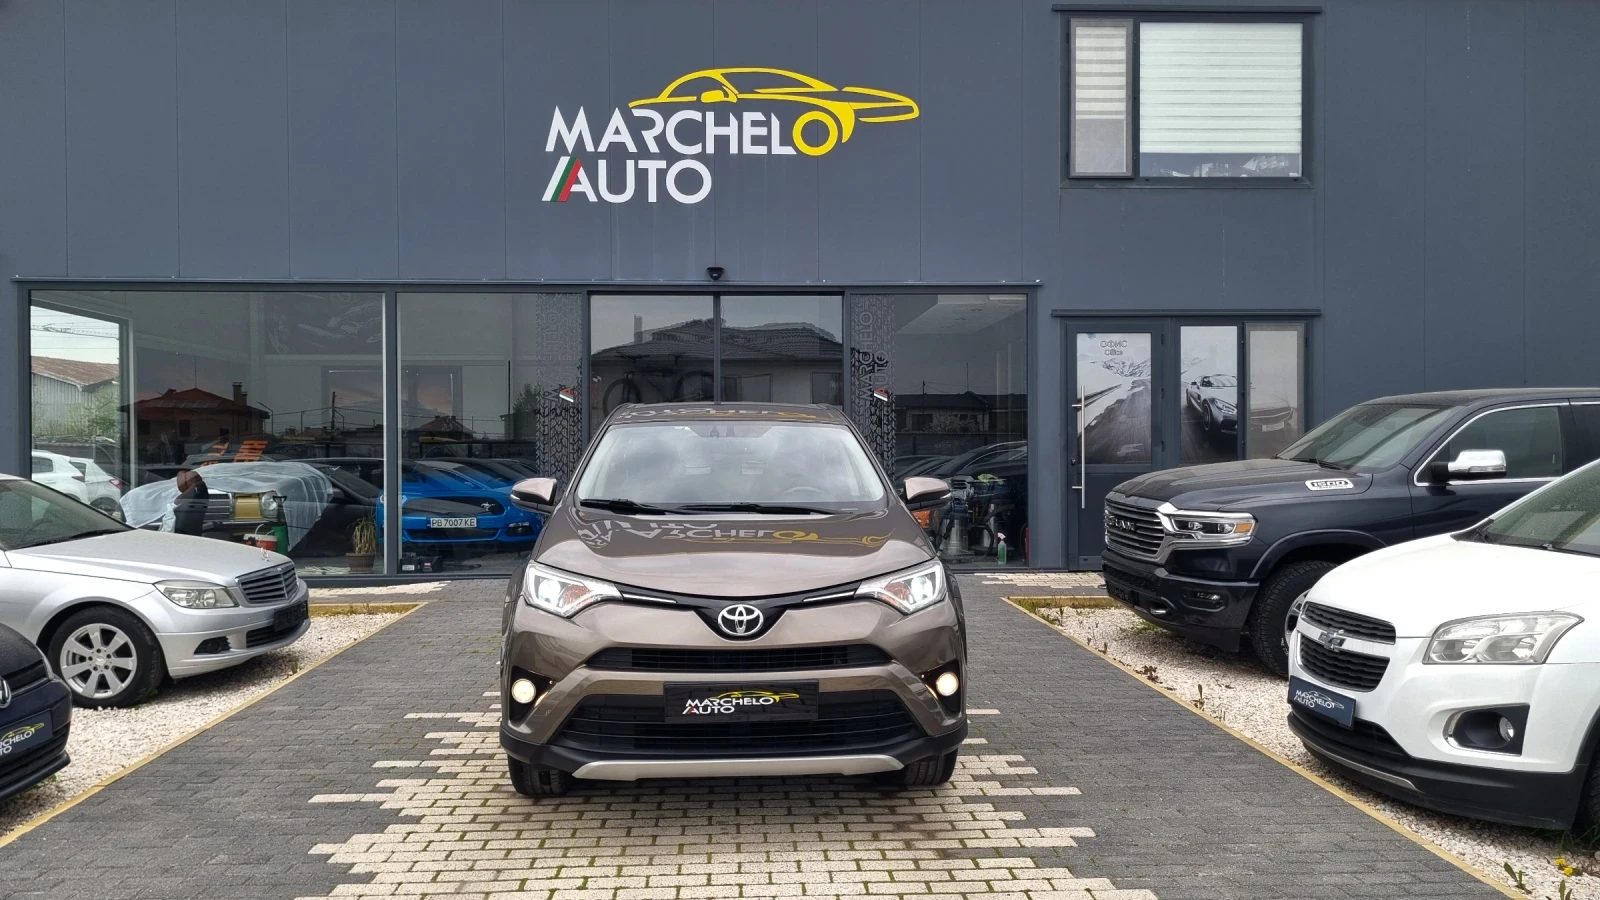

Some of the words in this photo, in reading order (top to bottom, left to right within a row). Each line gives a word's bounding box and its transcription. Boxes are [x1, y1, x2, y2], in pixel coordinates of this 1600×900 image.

[545, 105, 838, 156] MARCHELO
[541, 156, 712, 203] AUTO
[1100, 340, 1128, 348] ОФИС
[859, 311, 874, 401] MARCHELO
[873, 350, 889, 402] AUTO
[443, 519, 463, 527] 7007
[464, 519, 476, 527] KE
[685, 697, 774, 707] MARCHELO
[1293, 695, 1315, 708] AUTO
[1295, 689, 1332, 709] MARCHELO
[682, 706, 735, 715] AUTO
